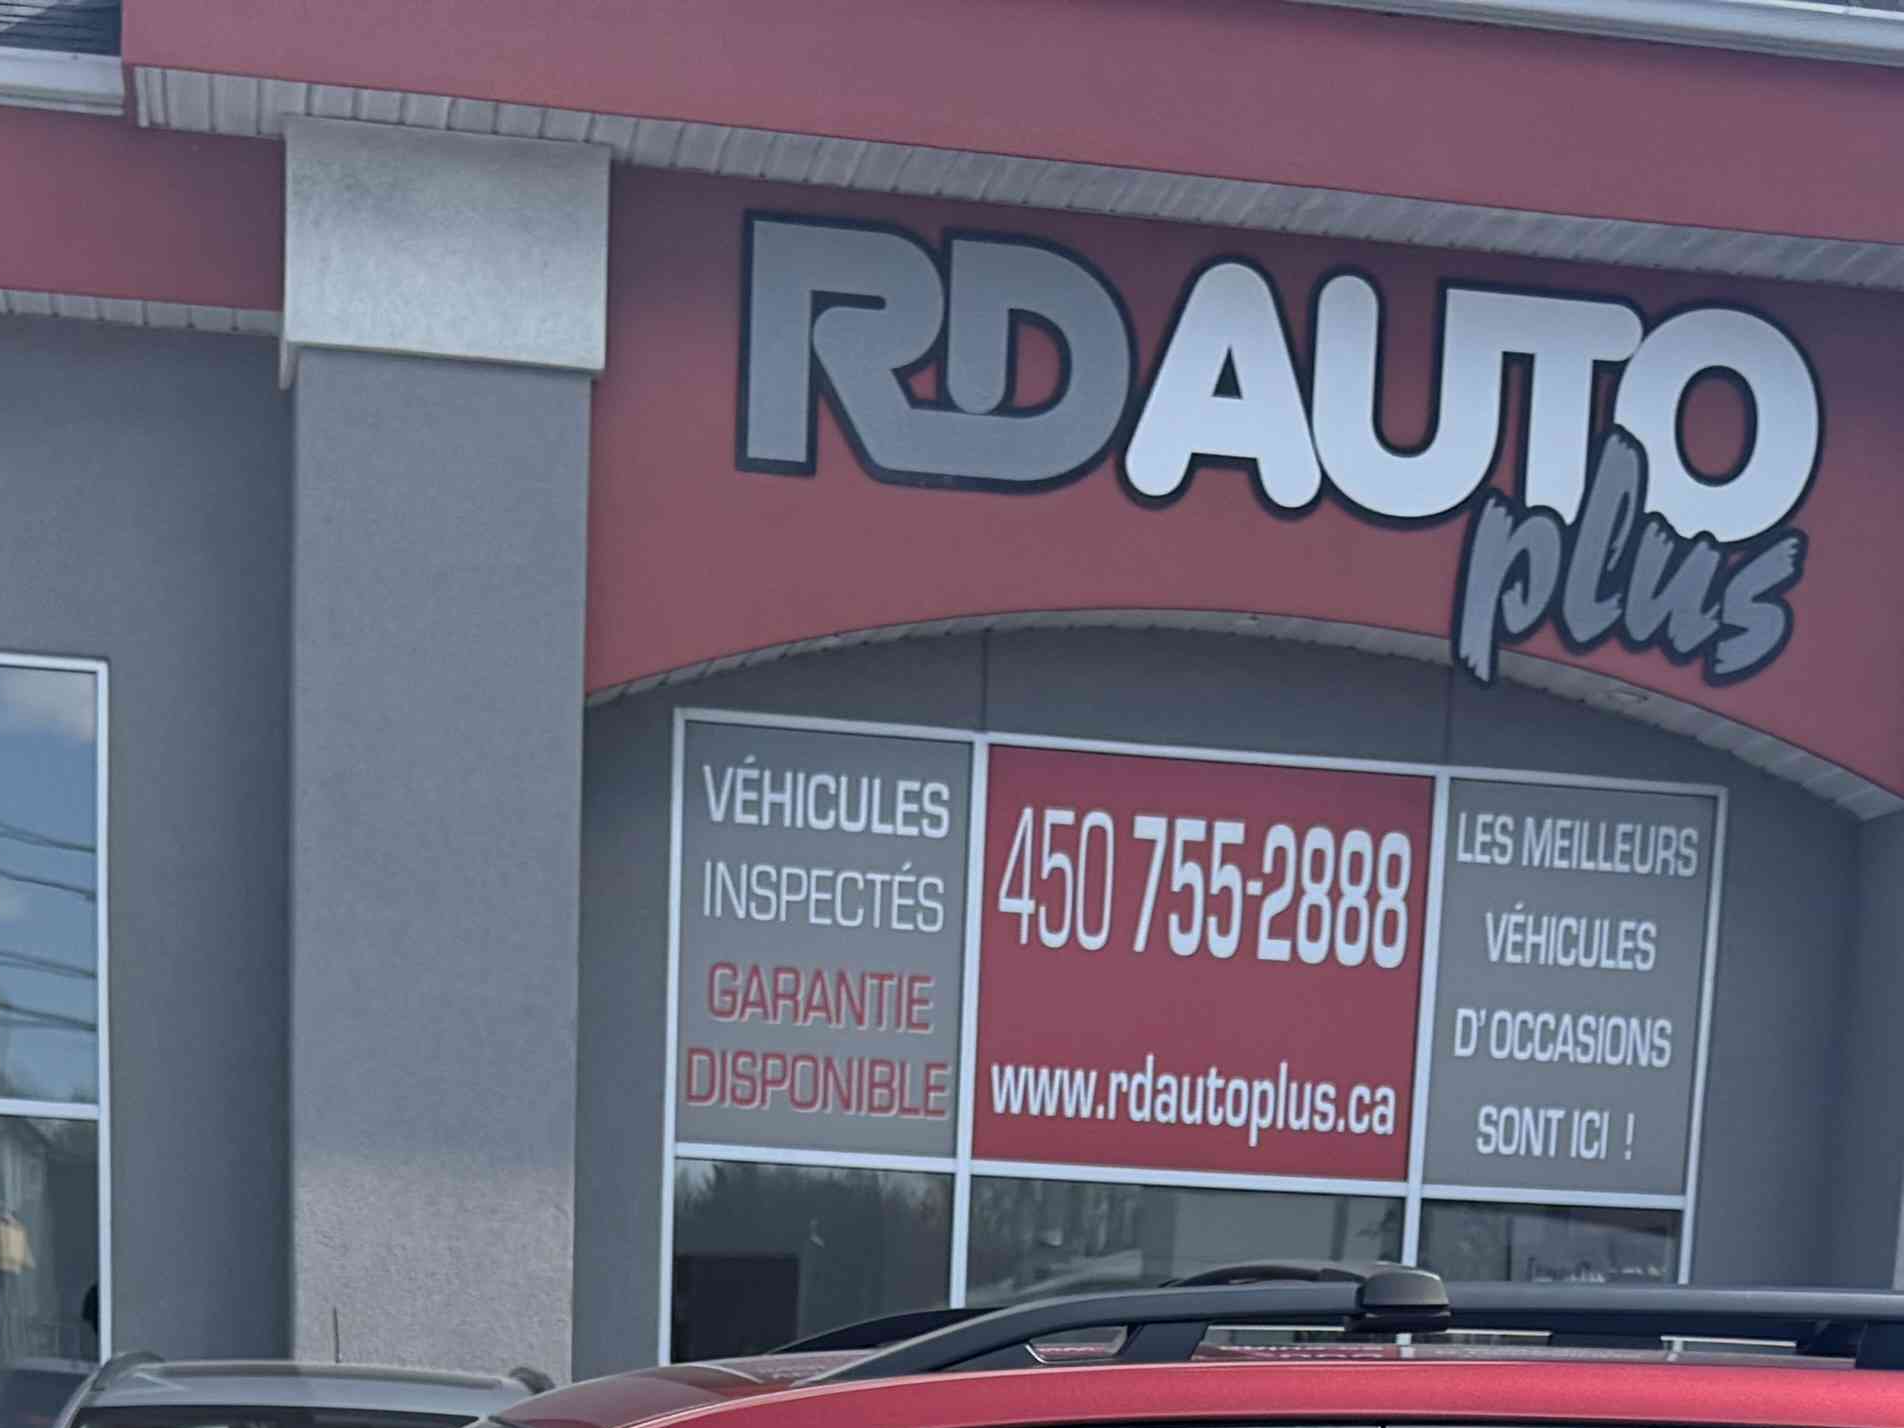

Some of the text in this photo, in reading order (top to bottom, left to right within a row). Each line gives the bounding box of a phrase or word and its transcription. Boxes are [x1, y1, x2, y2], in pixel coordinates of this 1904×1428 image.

[1452, 424, 1807, 685] plus
[703, 754, 950, 838] VÉHICULES
[1456, 811, 1698, 877] LES MEILLEURS
[703, 860, 945, 933] INSPECTÉS
[998, 806, 1412, 968] 450 755-2888
[1485, 902, 1657, 971] VÉHICULES
[707, 961, 935, 1034] GARANTIE
[686, 1047, 952, 1120] DISPONIBLE
[991, 1053, 1396, 1147] www.rdautoplus.ca
[1476, 1105, 1566, 1157] SONT
[1570, 1110, 1610, 1160] ICI
